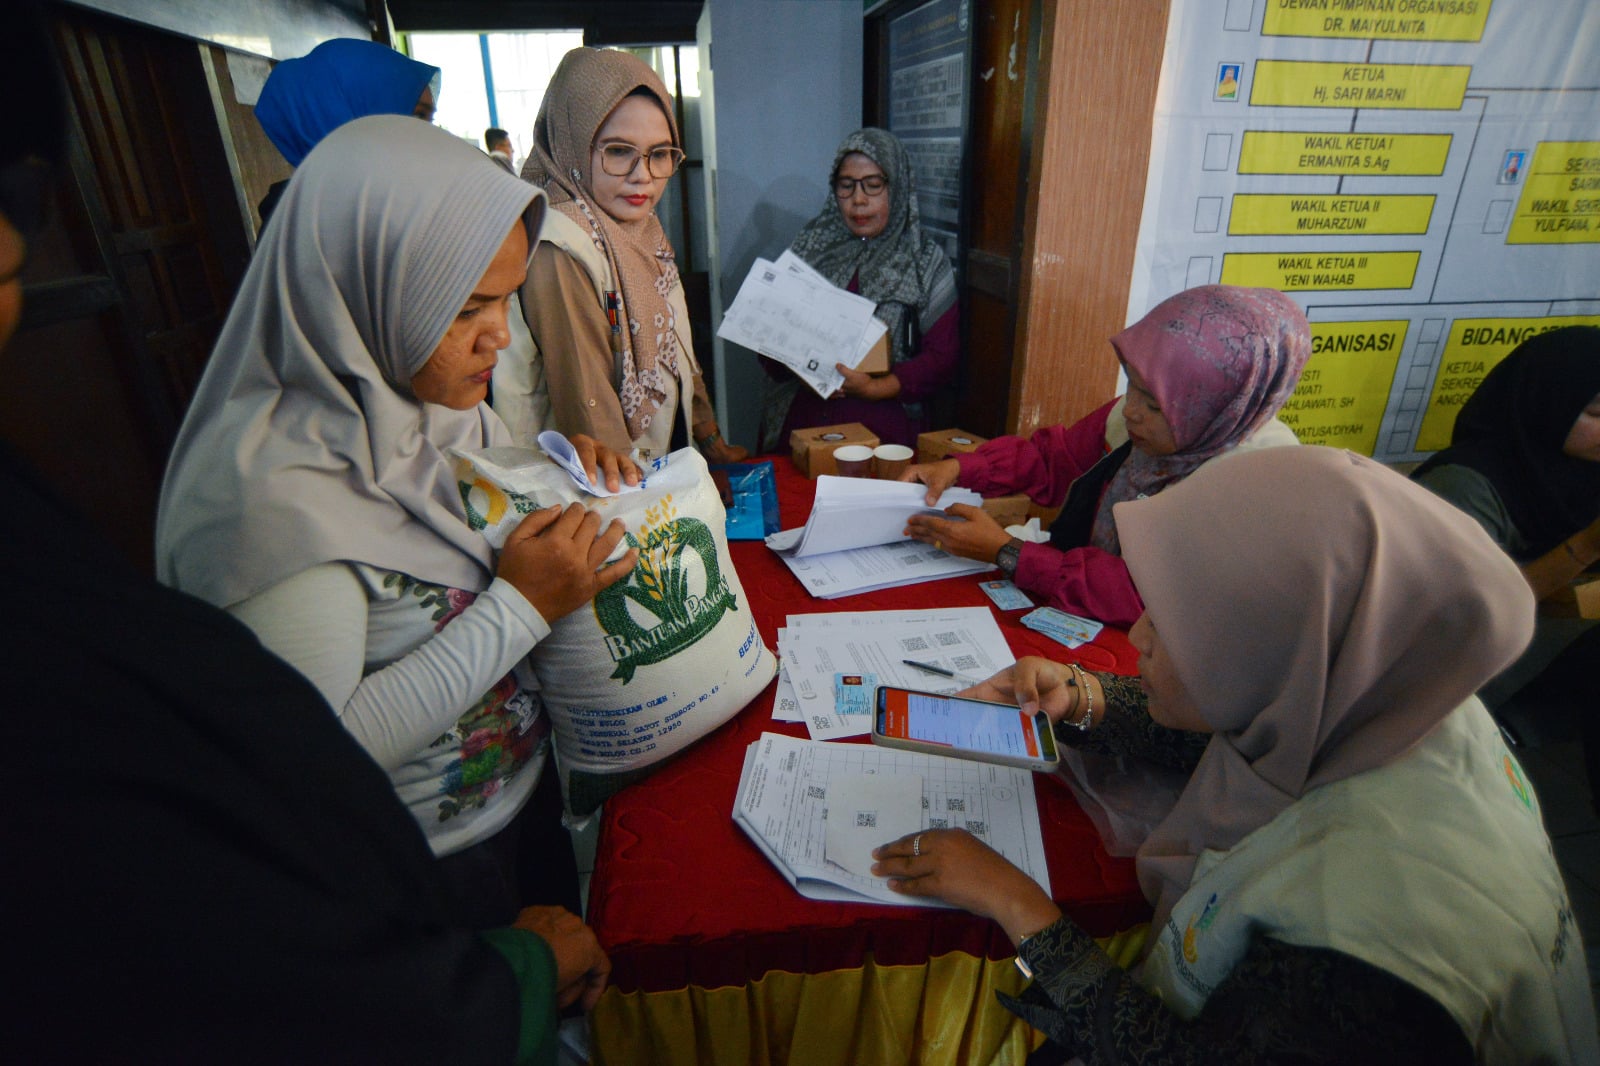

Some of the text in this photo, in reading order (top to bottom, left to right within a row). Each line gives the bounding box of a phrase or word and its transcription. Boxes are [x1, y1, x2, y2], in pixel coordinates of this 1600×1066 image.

[1397, 0, 1478, 15] ORGANISASI
[1323, 17, 1345, 31] DR.
[1343, 68, 1385, 81] KETUA
[1313, 86, 1407, 102] Hj. SARI MARNI
[1304, 136, 1394, 150] WAKIL KETUA I
[1298, 154, 1390, 171] ERMANITA S.Ag
[1290, 200, 1381, 212] WAKIL KETUA II
[1531, 199, 1569, 212] WAKIL
[1296, 218, 1367, 230] MUHARZUNI
[1277, 257, 1368, 269] WAKIL KETUA III
[1284, 273, 1356, 286] YENI WAHAB
[1311, 333, 1396, 353] GANISASI
[1461, 327, 1535, 346] BIDANG
[1446, 361, 1485, 374] KETUA
[1440, 377, 1482, 390] SEKRE
[1339, 396, 1355, 409] SH
[633, 720, 660, 734] GATOT
